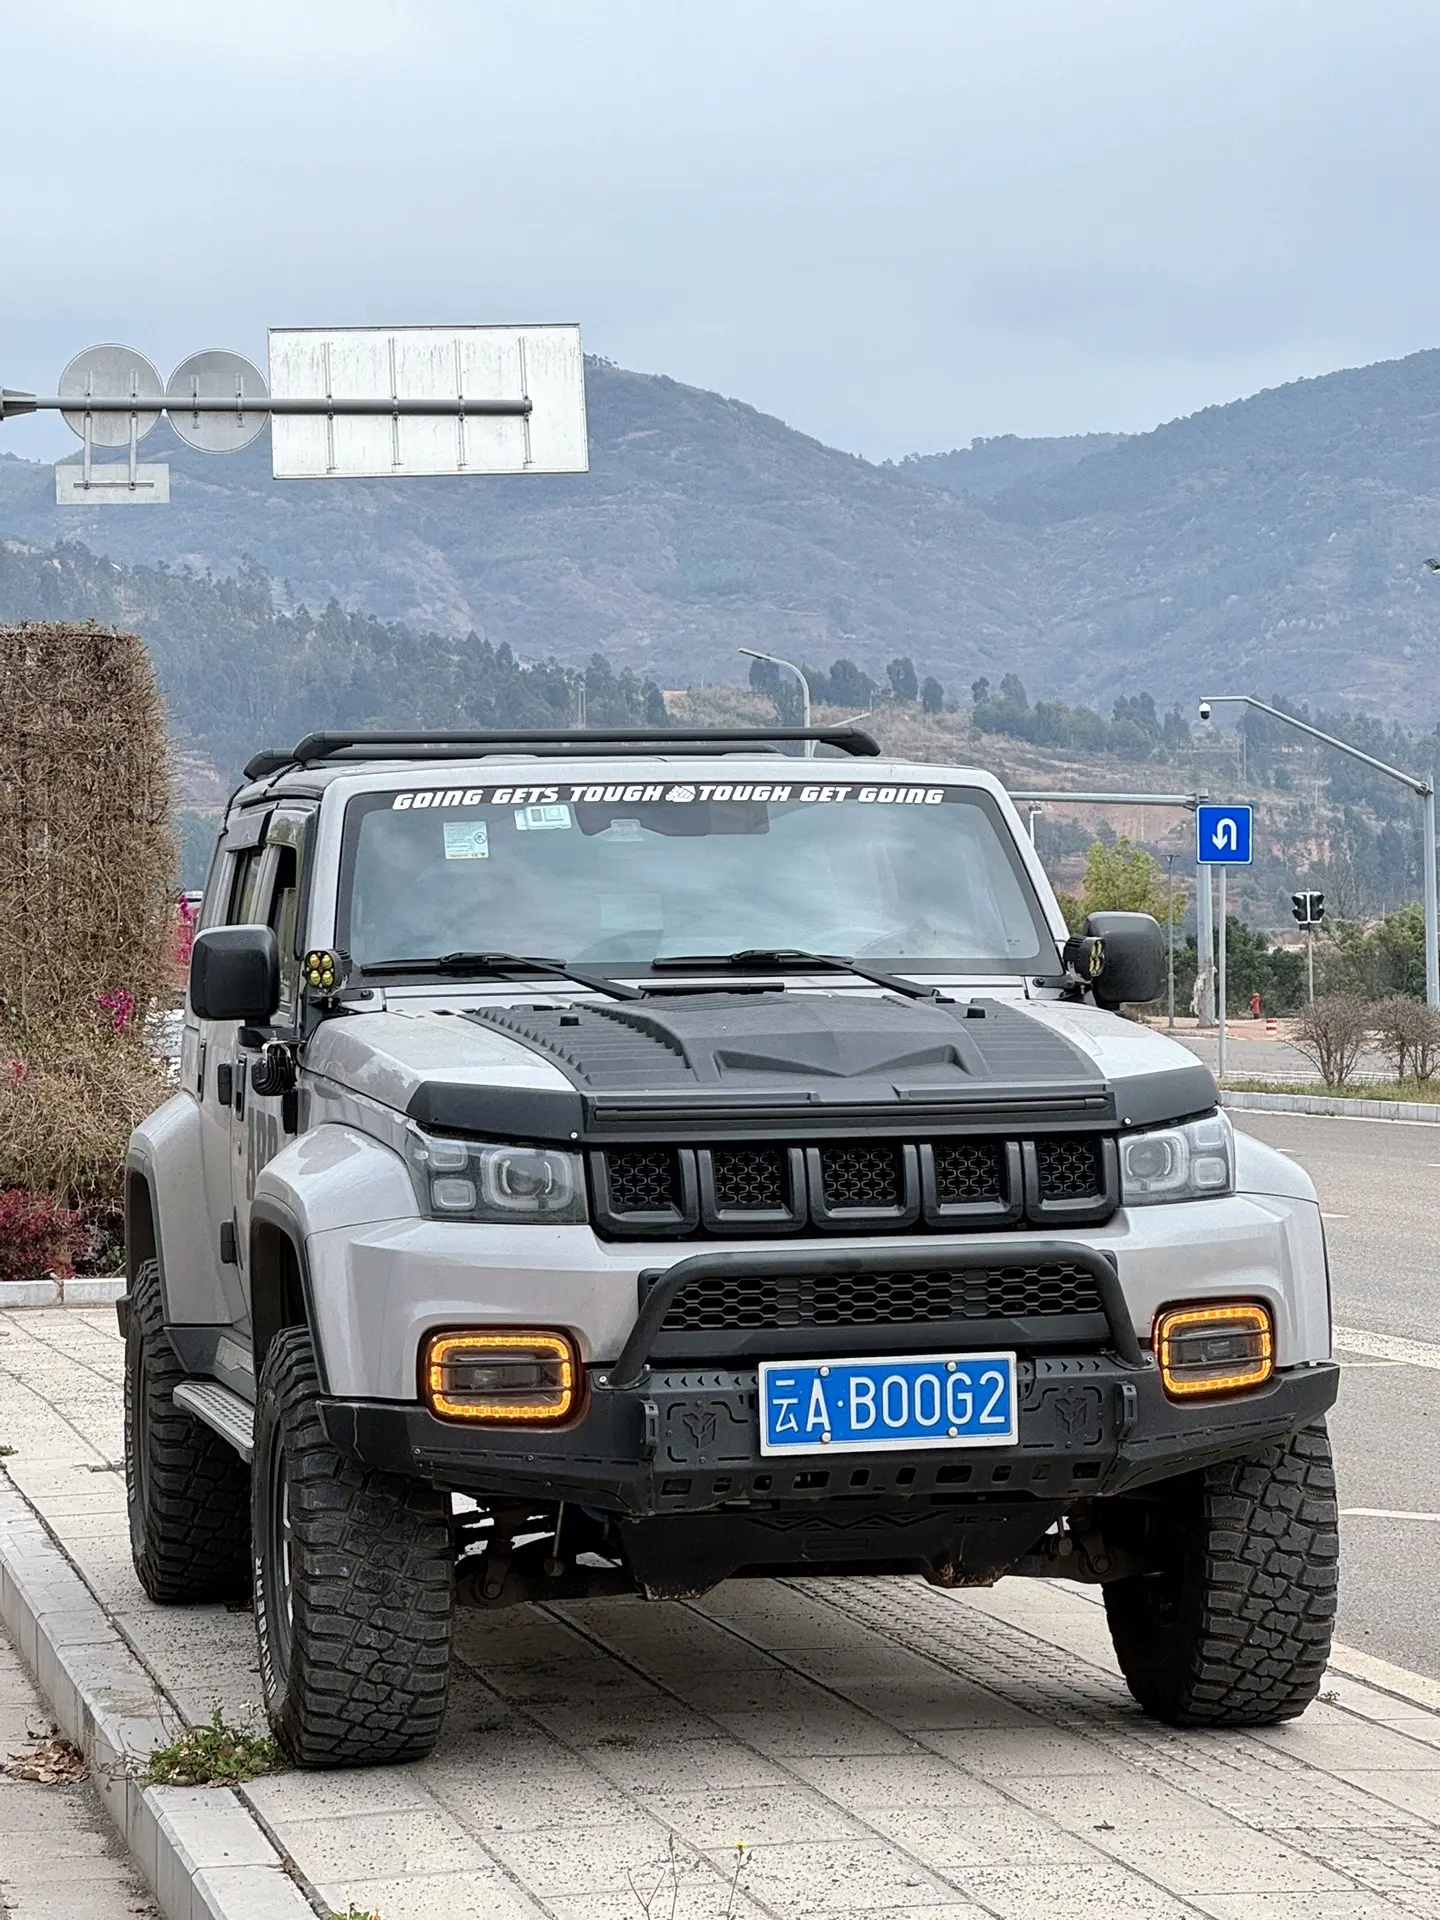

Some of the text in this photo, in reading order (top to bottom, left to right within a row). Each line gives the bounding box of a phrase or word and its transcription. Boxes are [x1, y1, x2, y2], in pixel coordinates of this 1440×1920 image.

[392, 785, 944, 810] GOING GETS TOUGH TOUGH GET GOING
[772, 1370, 1006, 1432] 云A·B00G2
[255, 1556, 277, 1699] BLACKBEAR
